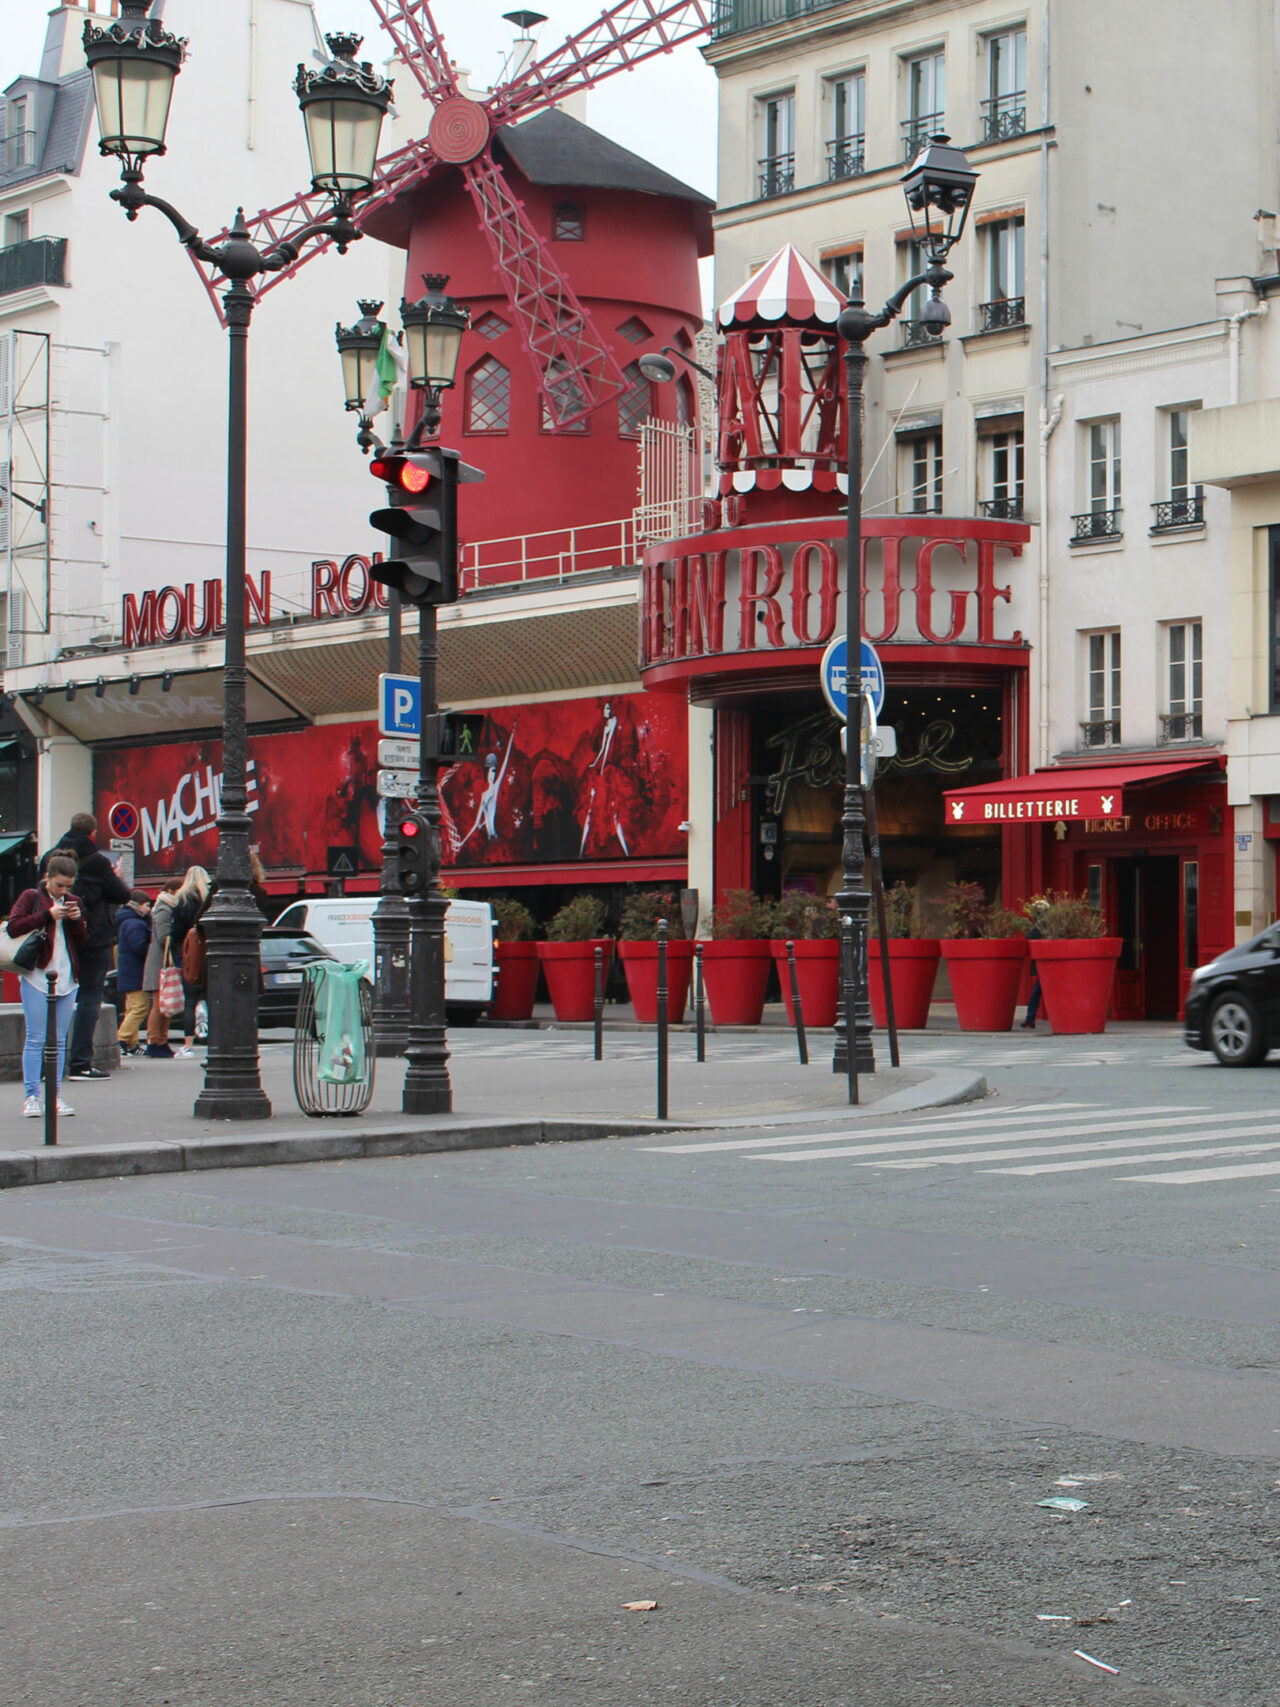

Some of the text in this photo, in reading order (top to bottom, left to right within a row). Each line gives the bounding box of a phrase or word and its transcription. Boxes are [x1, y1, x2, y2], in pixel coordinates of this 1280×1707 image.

[702, 494, 748, 532] DU
[122, 551, 390, 648] MOULN ROU
[738, 537, 1023, 648] ROUGE
[394, 688, 414, 724] P
[140, 760, 260, 857] MACHIE
[984, 798, 1079, 819] BILLETTERIE
[1084, 812, 1197, 833] TICKET OFFICE
